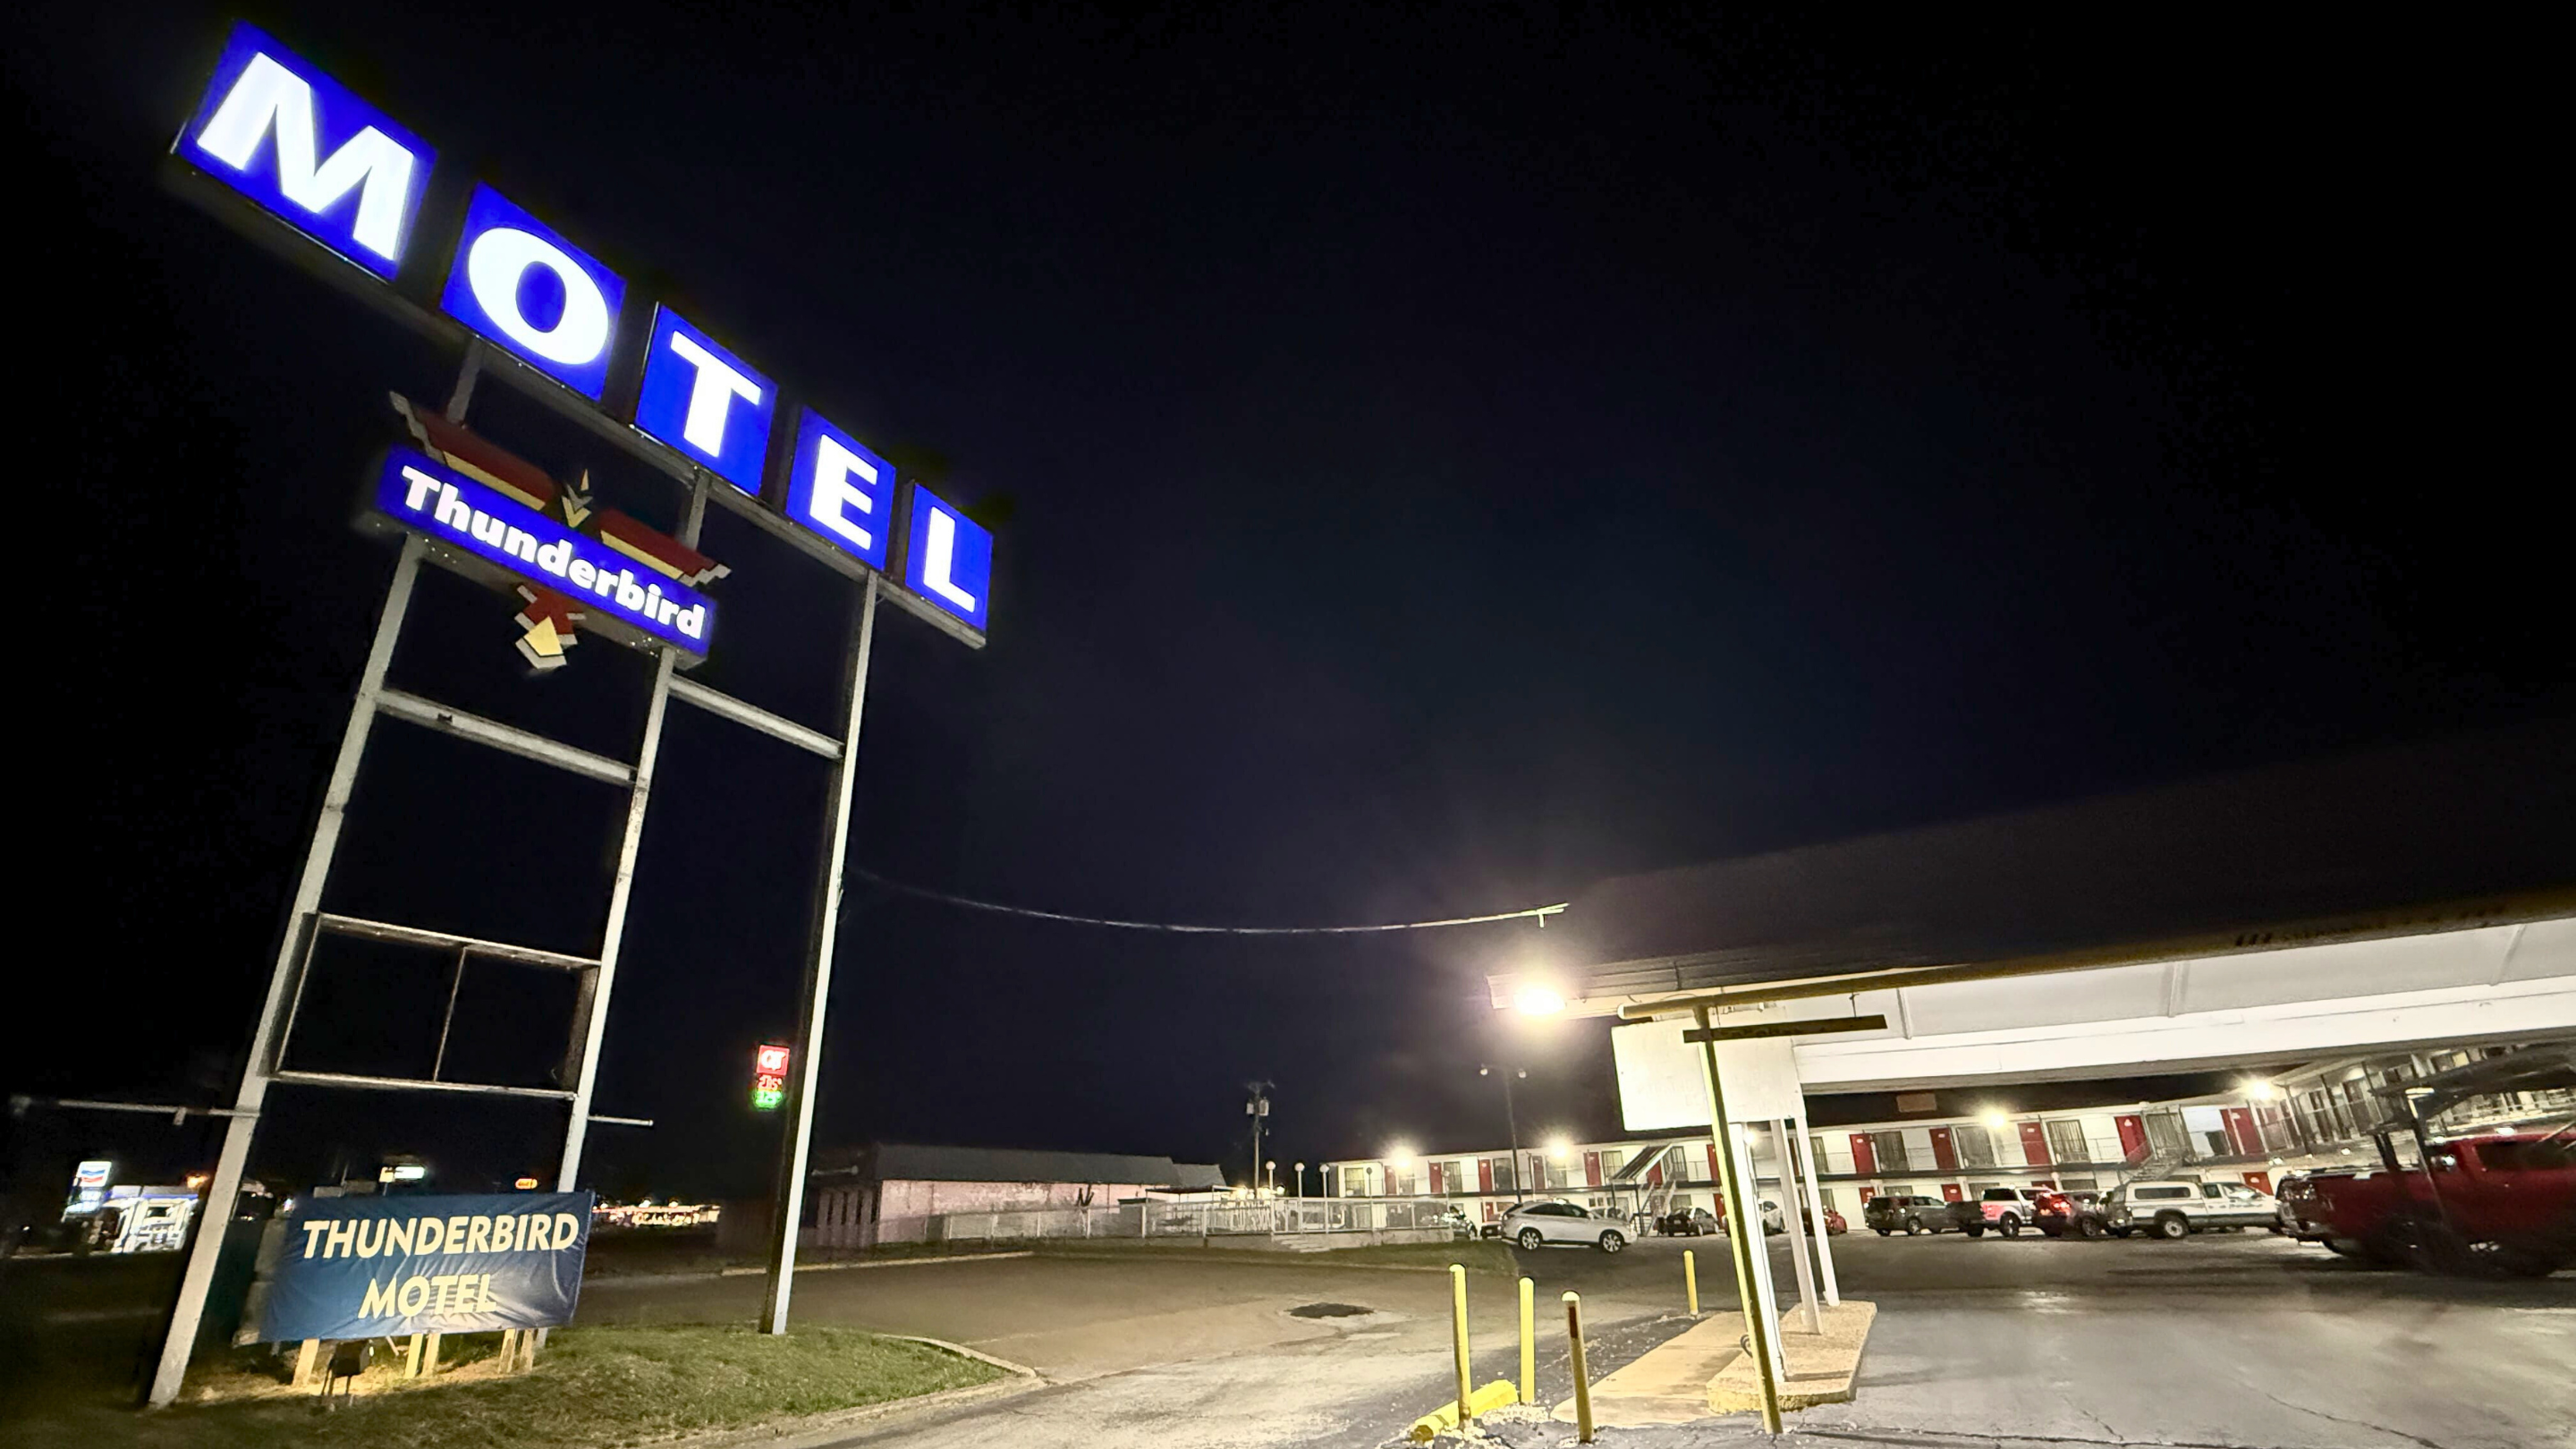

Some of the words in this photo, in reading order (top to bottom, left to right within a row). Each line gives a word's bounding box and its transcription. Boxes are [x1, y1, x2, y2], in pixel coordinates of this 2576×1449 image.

[198, 51, 977, 613] MOTEL
[402, 465, 705, 640] Thunderbird
[760, 1050, 786, 1071] QT
[303, 1213, 579, 1258] THUNDERBIRD
[358, 1274, 497, 1319] MOTEL
